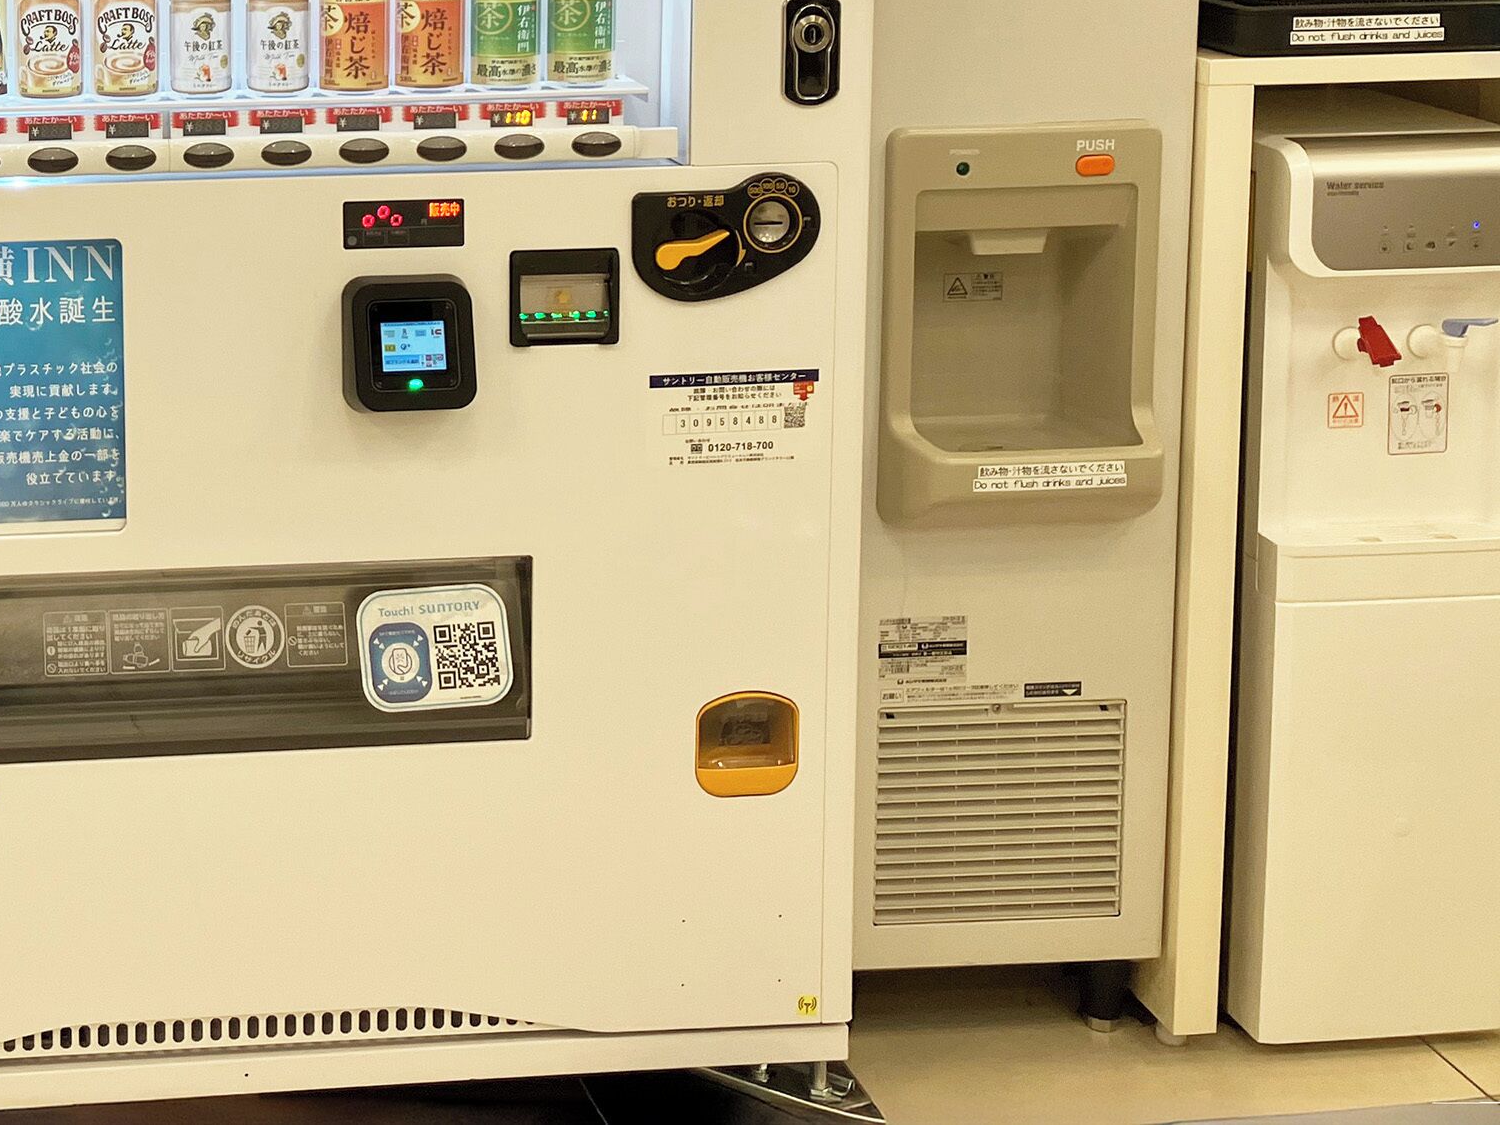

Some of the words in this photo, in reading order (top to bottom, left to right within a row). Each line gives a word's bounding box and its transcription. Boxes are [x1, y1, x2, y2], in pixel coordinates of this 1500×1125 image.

[21, 9, 54, 37] CRAFT
[54, 9, 78, 35] BOSS
[98, 7, 130, 35] CRAFT
[130, 7, 155, 33] BOSS
[1331, 32, 1355, 40] flush
[1359, 32, 1388, 40] drinks
[1393, 31, 1410, 39] and
[1414, 30, 1443, 39] juices
[32, 40, 69, 52] Latte
[184, 39, 223, 52] 午後の紅茶
[344, 11, 371, 80] 焙じ茶
[1076, 138, 1115, 151] PUSH
[667, 196, 725, 208] おつり・返却
[428, 202, 461, 218] 販売中
[662, 372, 806, 386] サントリー自動販売機お客様センター
[9, 383, 118, 398] 実現に貢献します。
[708, 441, 773, 453] 0120-718-700
[974, 480, 987, 489] Do
[991, 480, 1008, 489] not
[1014, 479, 1039, 488] flush
[1042, 478, 1070, 487] drinks
[1075, 478, 1093, 486] and
[1097, 477, 1125, 486] juices
[378, 606, 414, 617] Touch!
[420, 601, 480, 615] SUNTORY
